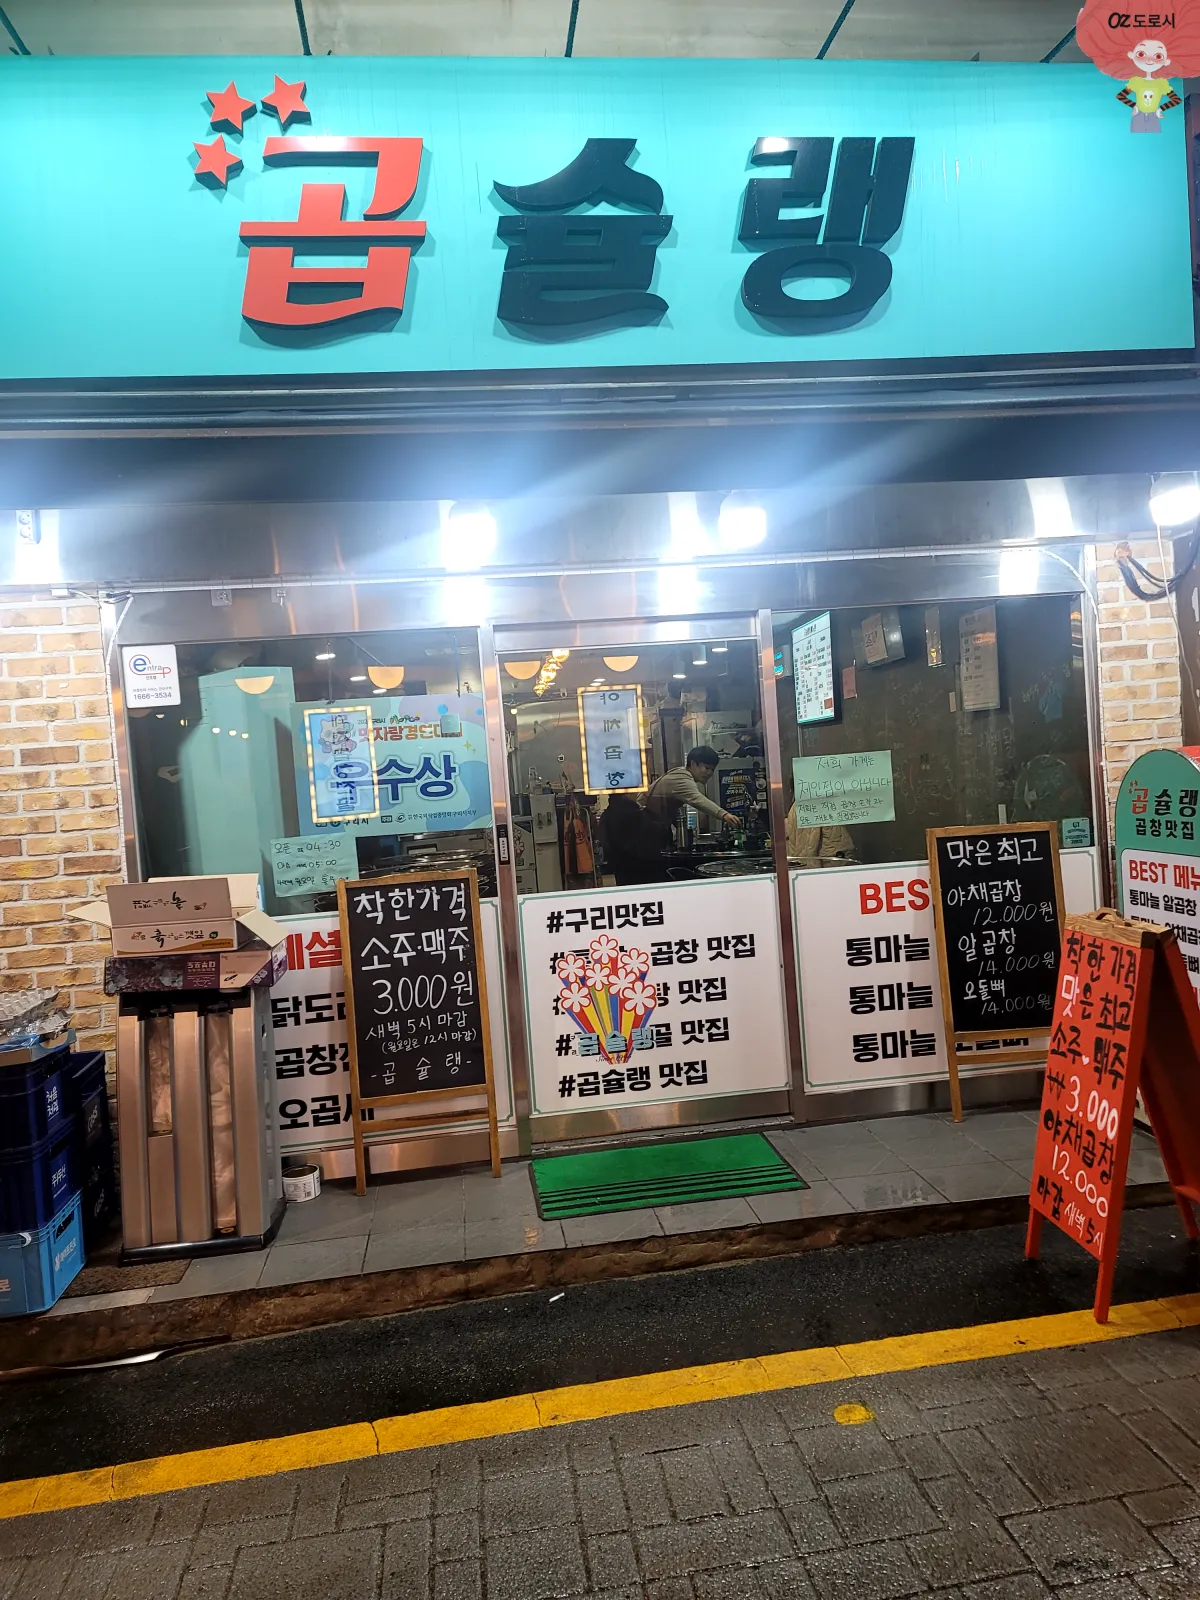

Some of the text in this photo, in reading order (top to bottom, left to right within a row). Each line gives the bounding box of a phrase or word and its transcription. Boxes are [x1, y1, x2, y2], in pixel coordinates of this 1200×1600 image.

[815, 755, 875, 770] 저희 가게는
[331, 755, 456, 803] 우수상
[797, 778, 892, 799] 체인점이 아닙니다
[1135, 818, 1195, 840] 곱창맛집
[947, 837, 1044, 868] 맛은 최고
[1129, 859, 1168, 884] BEST
[354, 883, 466, 925] 착한가격
[947, 879, 1022, 906] 야채곱창
[1129, 889, 1197, 917] 통마늘 알곱창
[546, 901, 665, 933] #구리맛집
[973, 901, 1055, 926] 12.000원
[651, 939, 699, 966] 곱창
[707, 934, 756, 961] 맛집
[846, 934, 931, 967] 통마늘
[978, 951, 1056, 976] 14.000원
[678, 977, 727, 1004] 맛집
[849, 981, 934, 1015] 통마늘
[963, 979, 1006, 1001] 오돌뼈
[1062, 975, 1131, 1035] 맛은 최고
[365, 1011, 468, 1041] 새벽 5시 마감
[424, 1031, 448, 1045] 12시
[681, 1017, 730, 1045] 맛집
[852, 1029, 937, 1063] 통마늘
[558, 1060, 708, 1098] #곱슐랭 맛집
[1043, 1109, 1115, 1185] 야채곱창
[1052, 1145, 1109, 1218] 12.000
[1037, 1175, 1064, 1221] 마감
